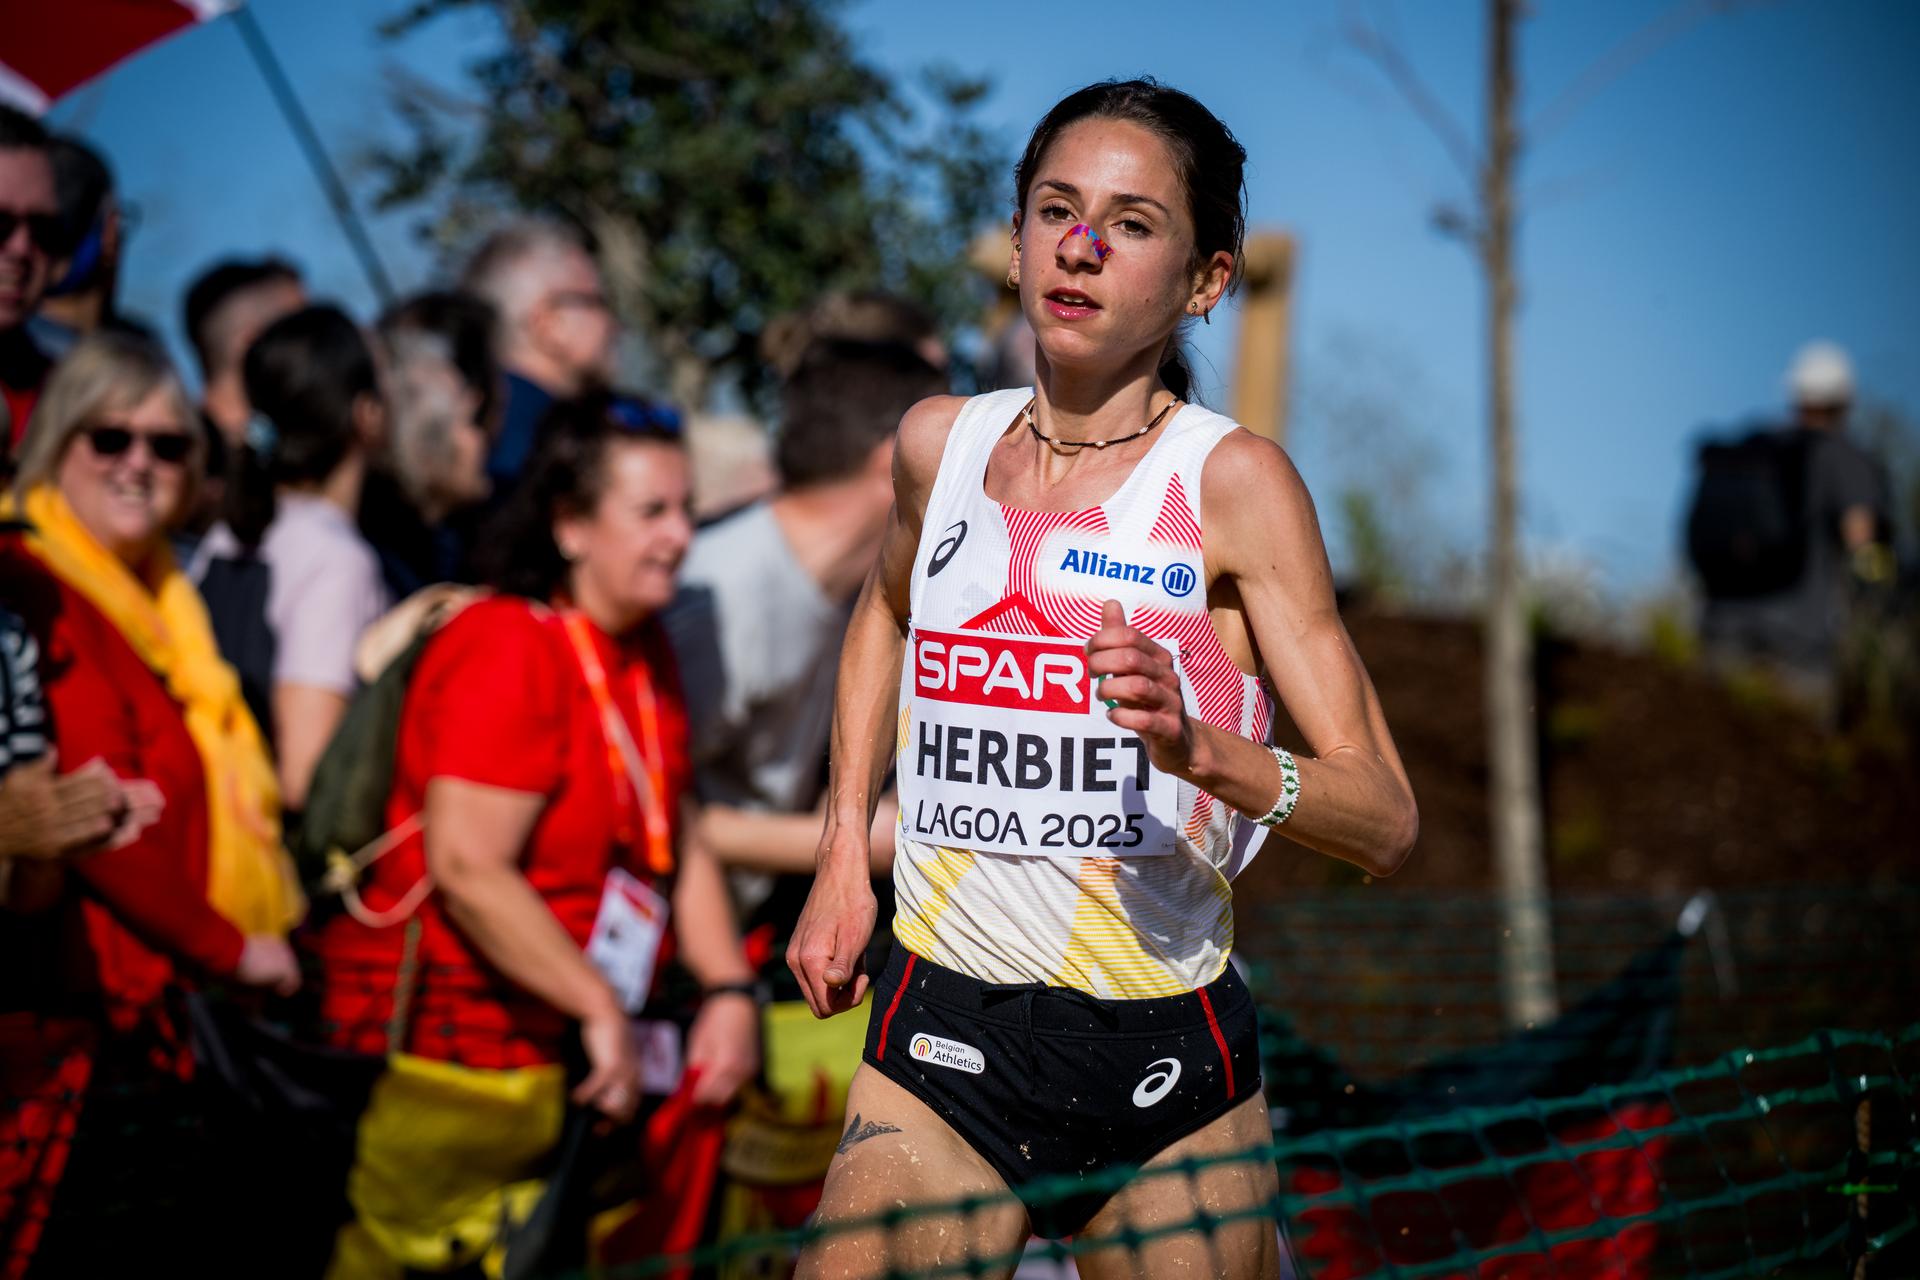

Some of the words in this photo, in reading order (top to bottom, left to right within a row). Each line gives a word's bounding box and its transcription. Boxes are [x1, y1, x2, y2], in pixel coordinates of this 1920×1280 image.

[1060, 548, 1155, 586] Allianz
[918, 641, 1084, 703] SPAR
[916, 721, 1150, 792] HERBIET
[915, 799, 1028, 846] LAGOA
[1040, 813, 1144, 848] 2025
[933, 1051, 982, 1071] Athletics
[935, 1040, 965, 1054] Belgian
